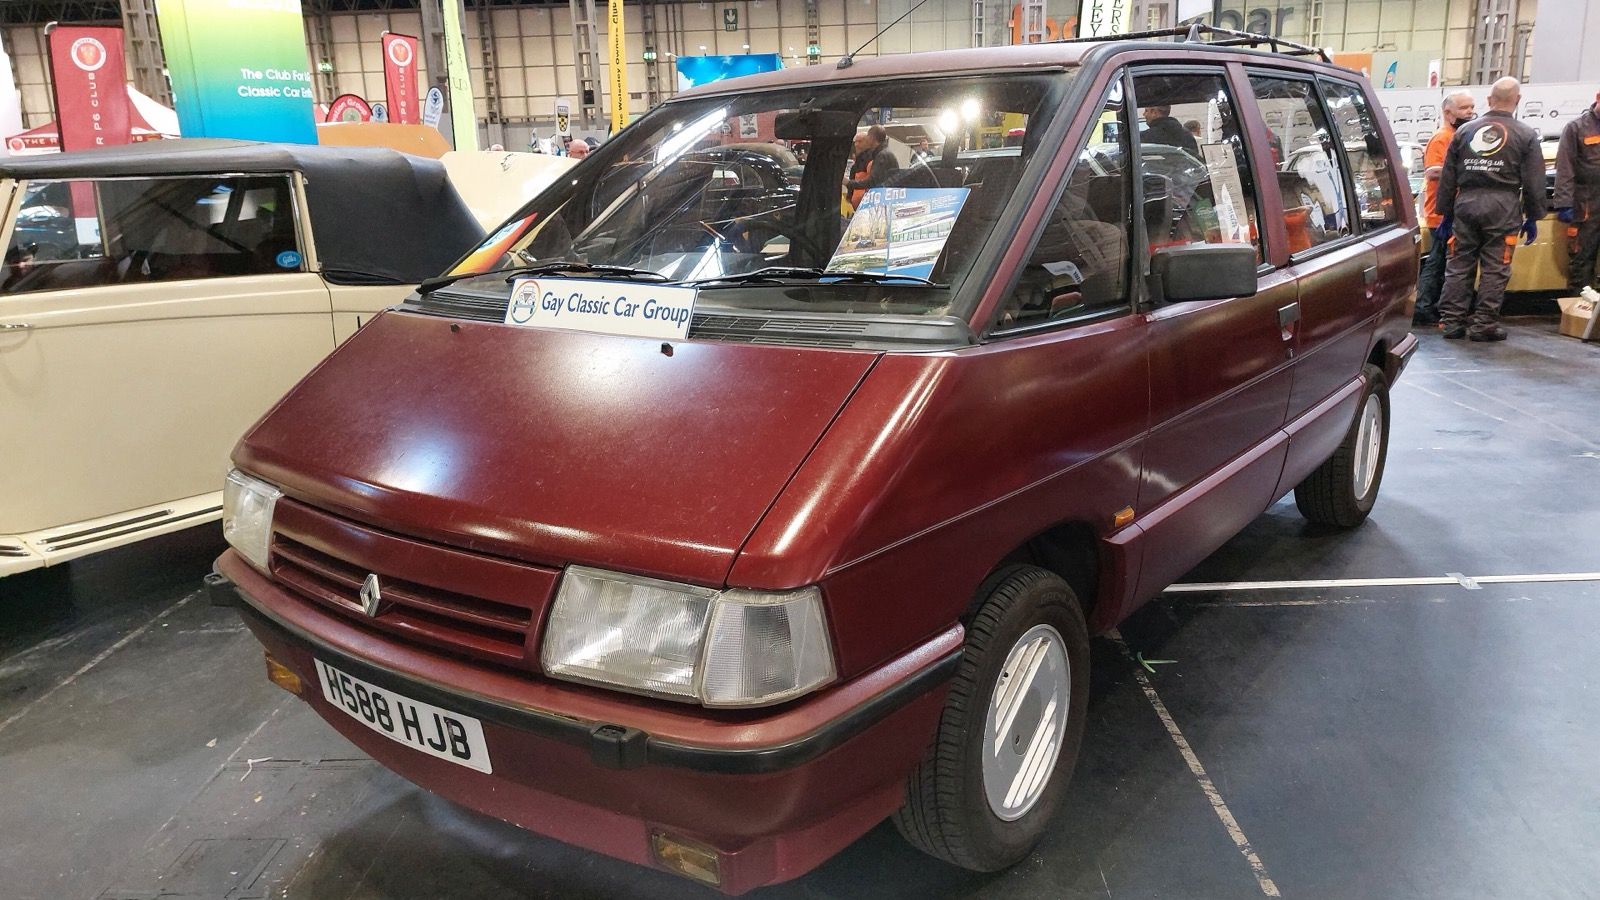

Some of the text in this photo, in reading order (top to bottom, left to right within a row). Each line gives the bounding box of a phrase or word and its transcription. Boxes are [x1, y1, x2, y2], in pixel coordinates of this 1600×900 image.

[1213, 0, 1294, 40] bar
[87, 72, 99, 108] CLUB
[240, 68, 263, 80] The
[265, 69, 291, 81] Club
[292, 70, 304, 81] For
[398, 68, 406, 96] CLUB
[237, 85, 280, 97] Classic
[283, 86, 300, 98] Car
[92, 113, 102, 131] P6
[541, 291, 690, 329] Gay Classic Car Group
[322, 663, 472, 761] H588 HJB
